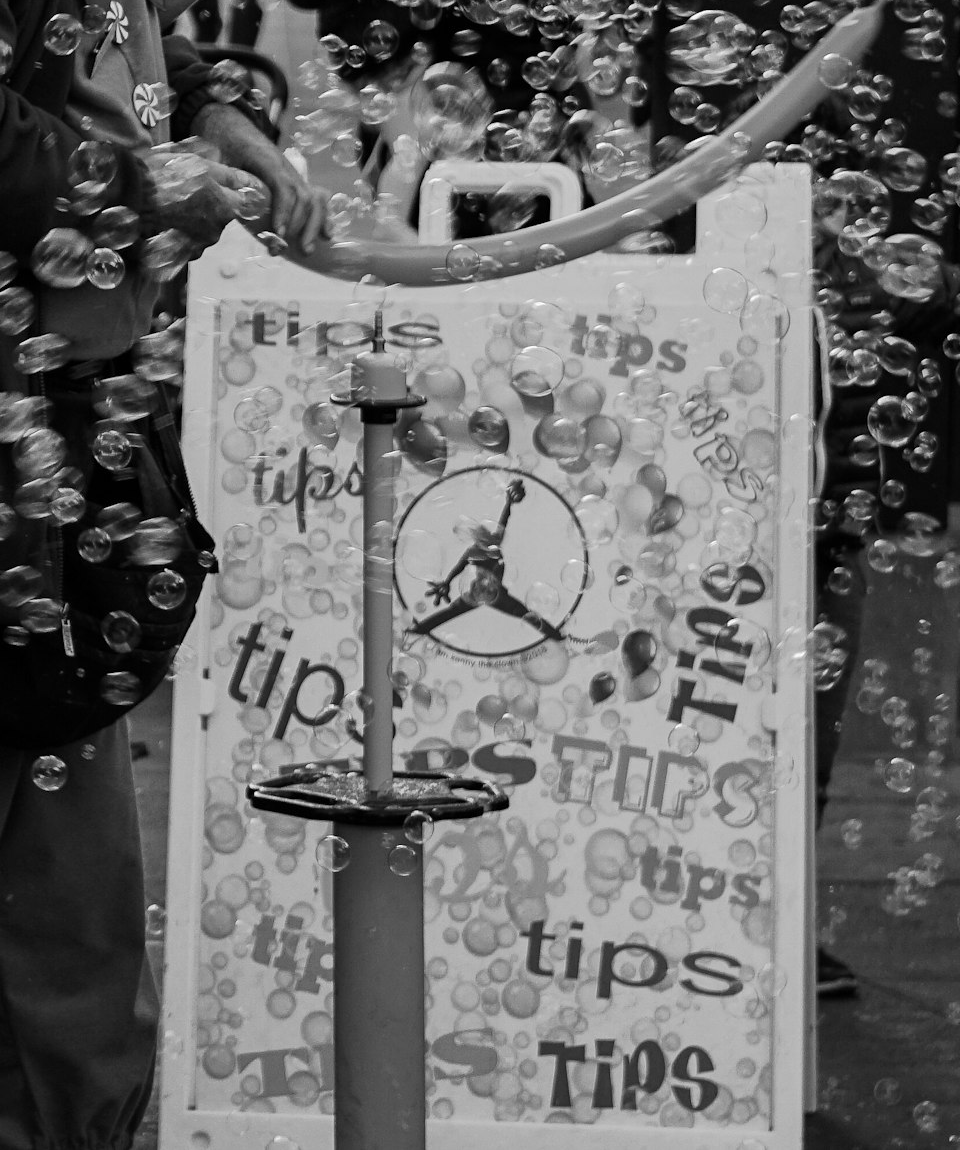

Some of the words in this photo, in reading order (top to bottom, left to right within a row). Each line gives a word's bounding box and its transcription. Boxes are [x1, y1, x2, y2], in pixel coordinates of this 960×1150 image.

[249, 310, 443, 355] tips
[570, 314, 689, 378] tips
[551, 733, 764, 828] TIPS
[639, 846, 762, 912] tips
[251, 913, 334, 995] tip
[519, 919, 745, 999] tips
